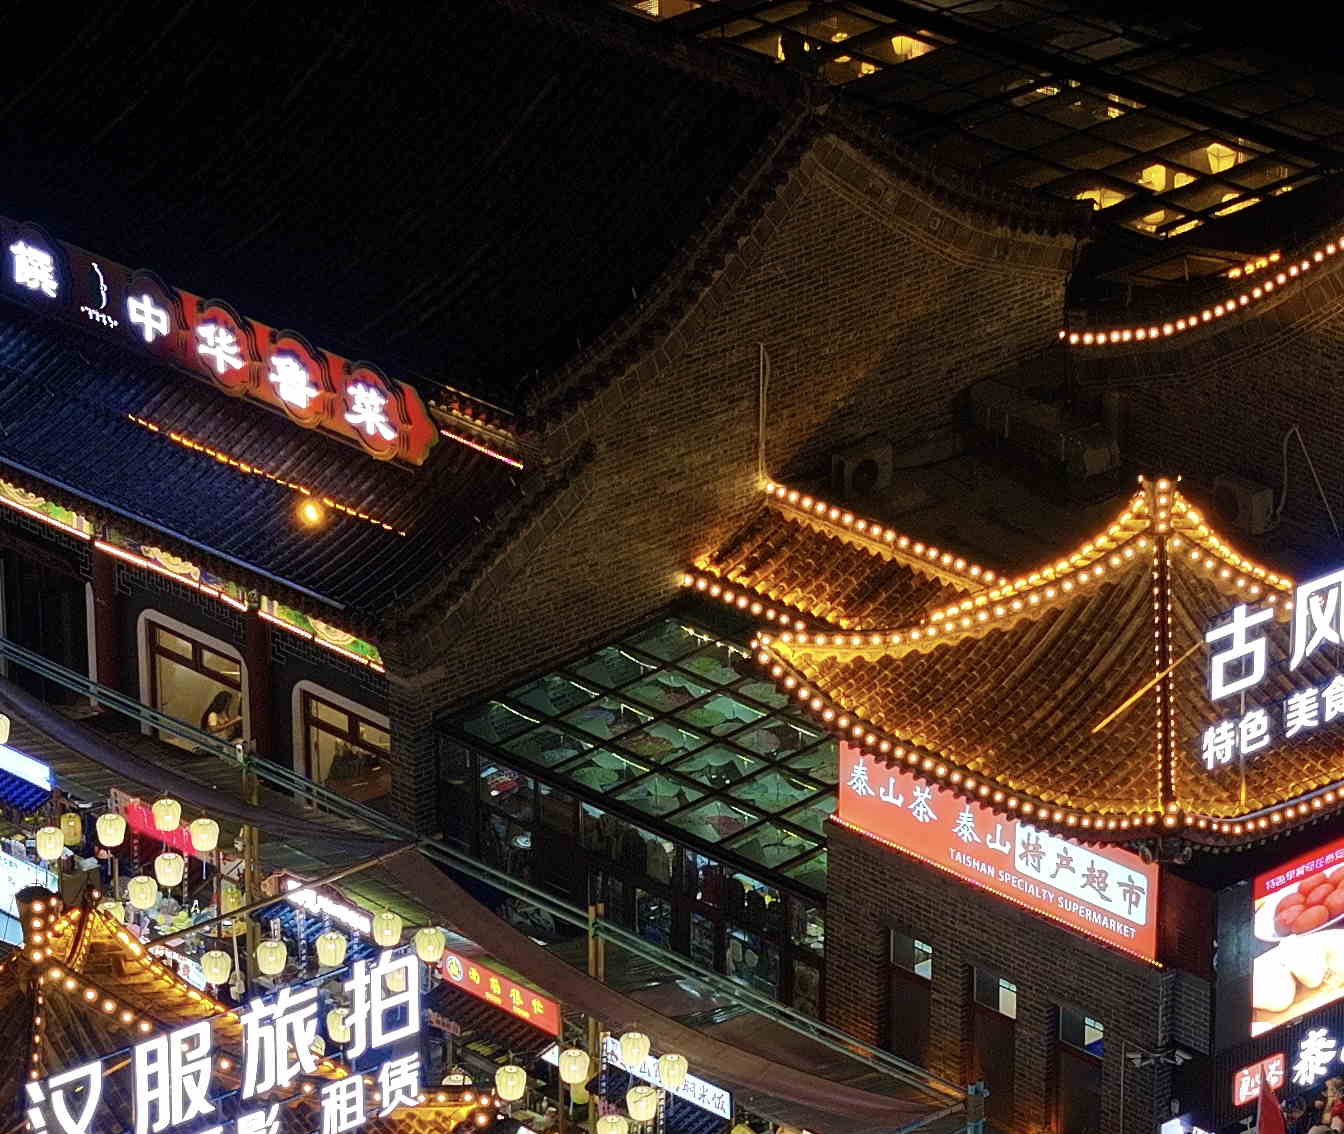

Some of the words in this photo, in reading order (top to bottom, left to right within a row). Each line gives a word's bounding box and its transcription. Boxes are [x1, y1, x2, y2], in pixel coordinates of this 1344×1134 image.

[126, 294, 397, 442] 中华鲁菜
[1201, 710, 1272, 770] 特色
[847, 757, 938, 823] 泰山茶
[952, 804, 1146, 916] 泰山特产超市
[948, 847, 995, 879] TAISHAN
[998, 870, 1056, 904] SPECIALTY
[1058, 895, 1137, 939] SUPERMARKET
